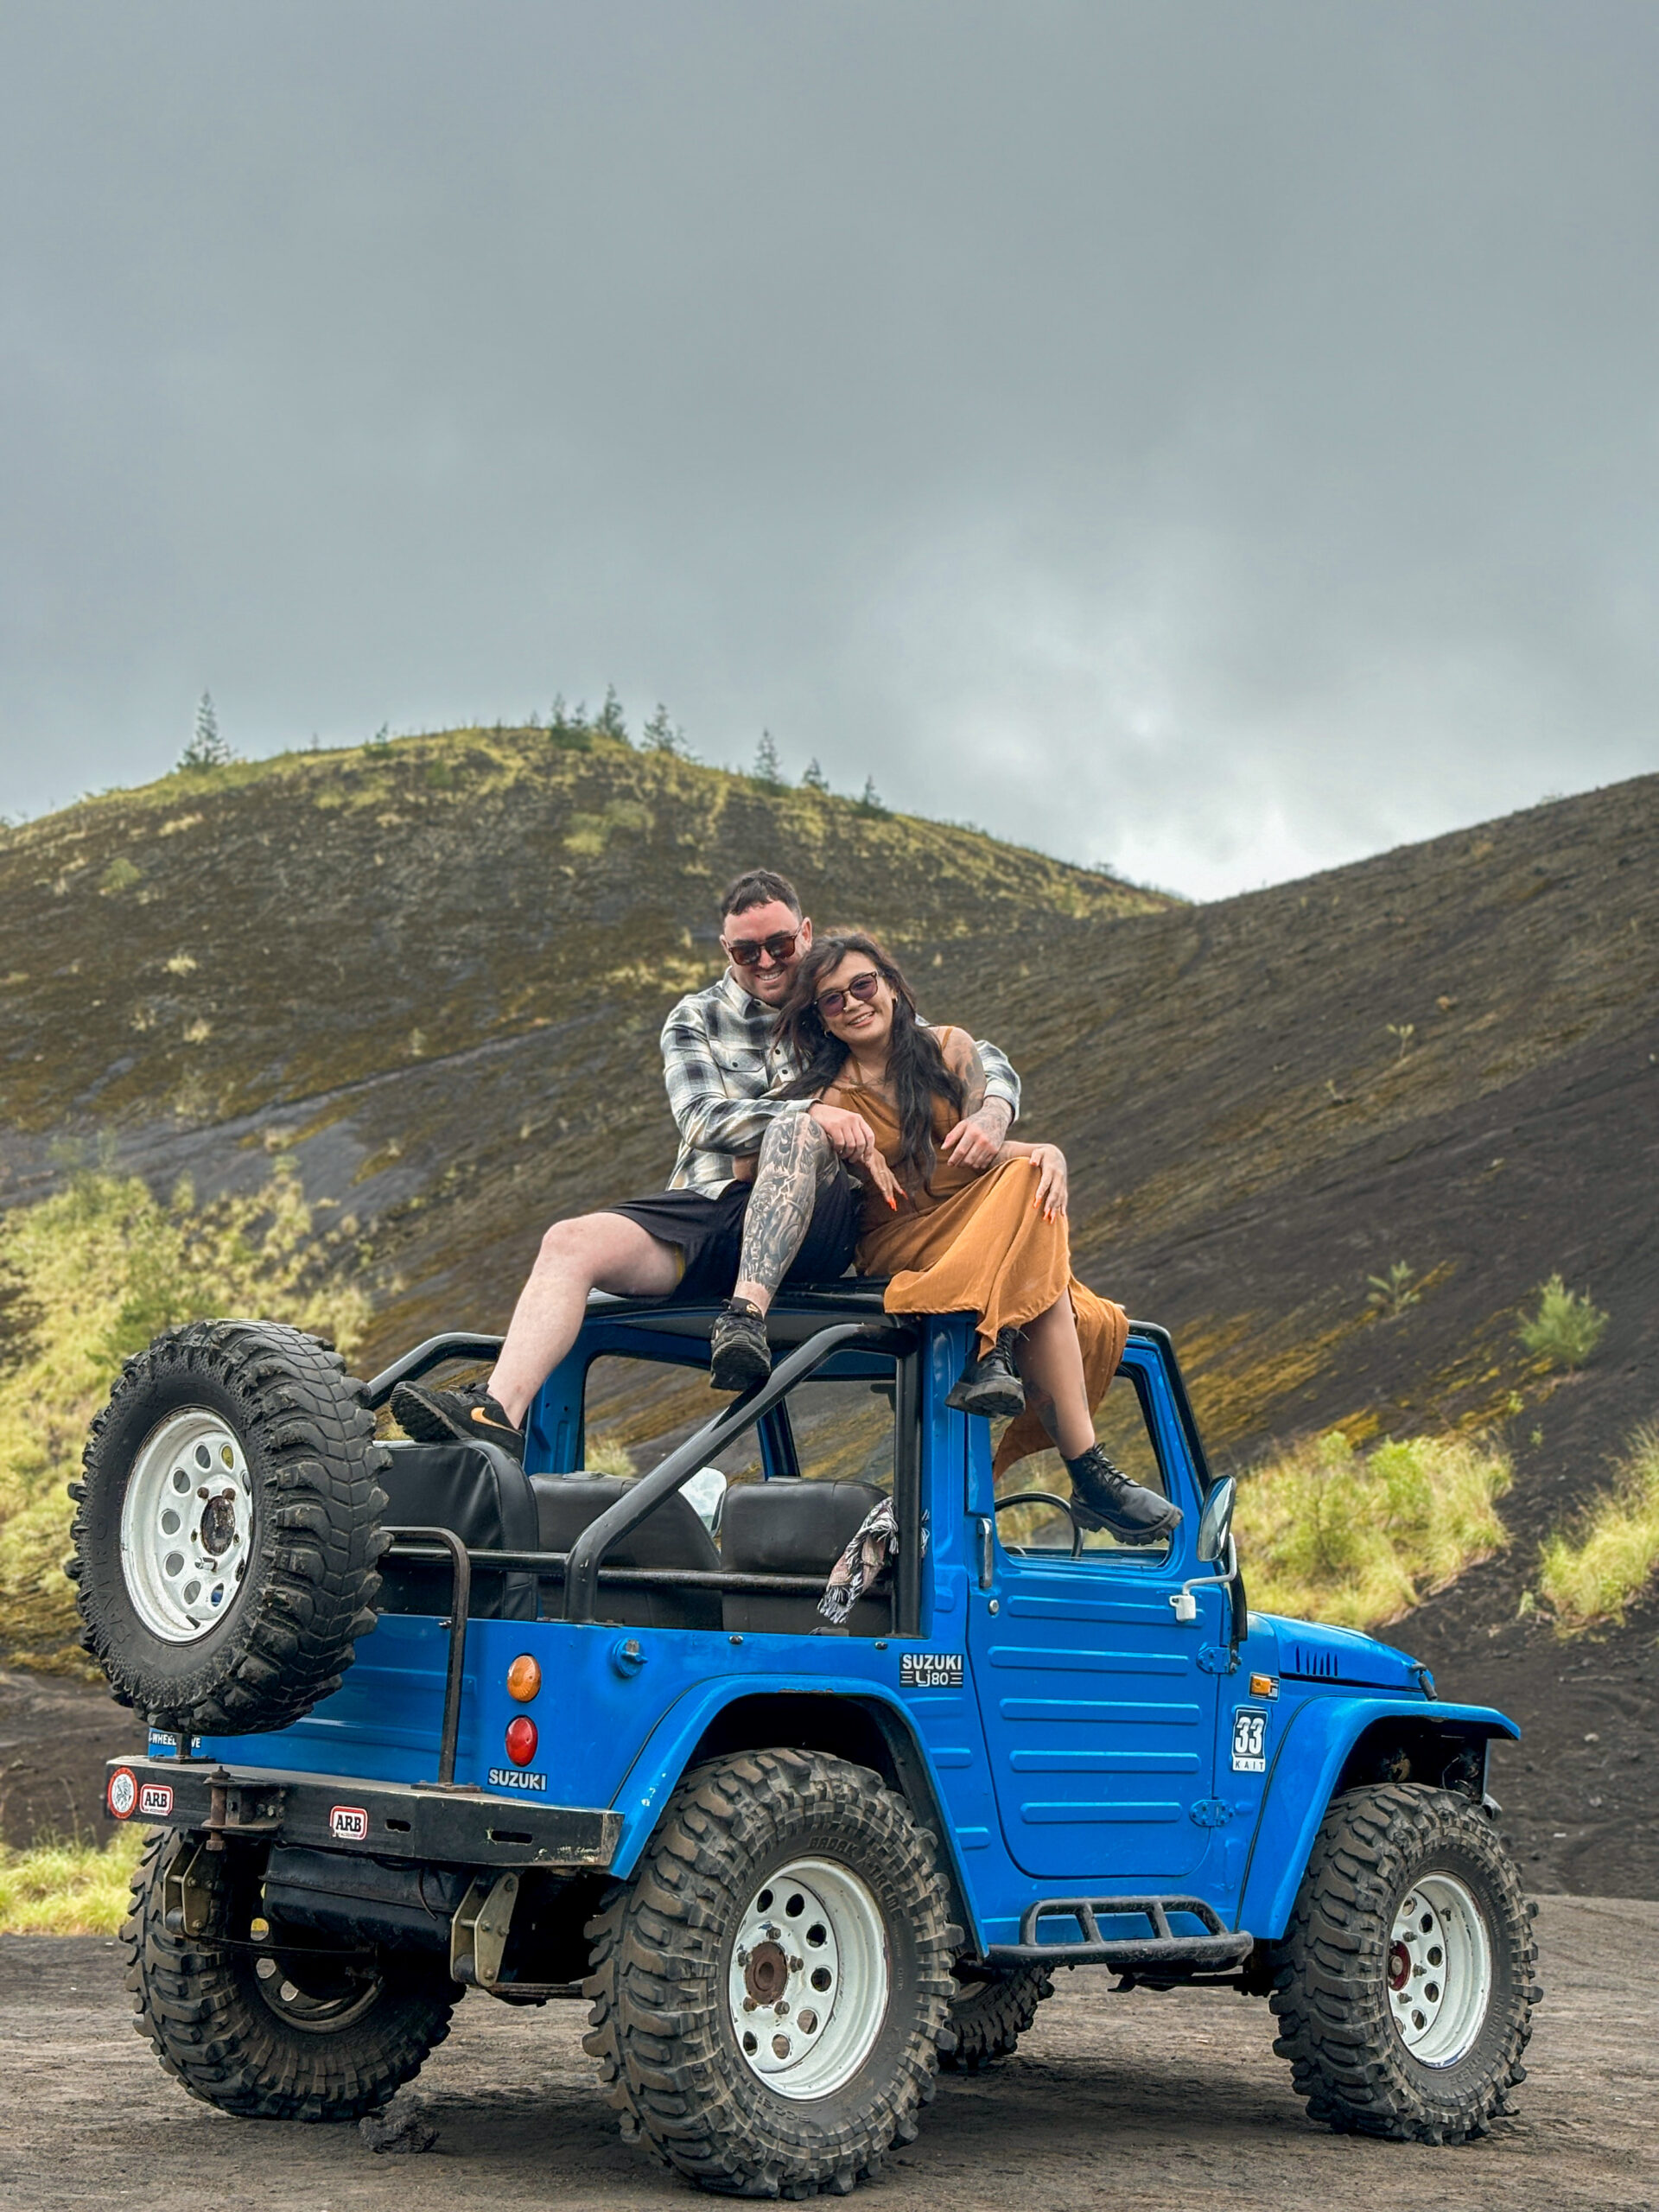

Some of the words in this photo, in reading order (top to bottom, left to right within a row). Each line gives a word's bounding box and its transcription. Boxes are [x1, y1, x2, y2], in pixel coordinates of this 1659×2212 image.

[902, 1654, 962, 1670] SUZUKI
[1235, 1716, 1264, 1754] 33
[1235, 1760, 1264, 1770] KAIT
[488, 1769, 547, 1790] SUZUKI
[144, 1791, 168, 1808] ARB
[335, 1814, 361, 1833] ARB
[809, 1835, 858, 1858] BADAK
